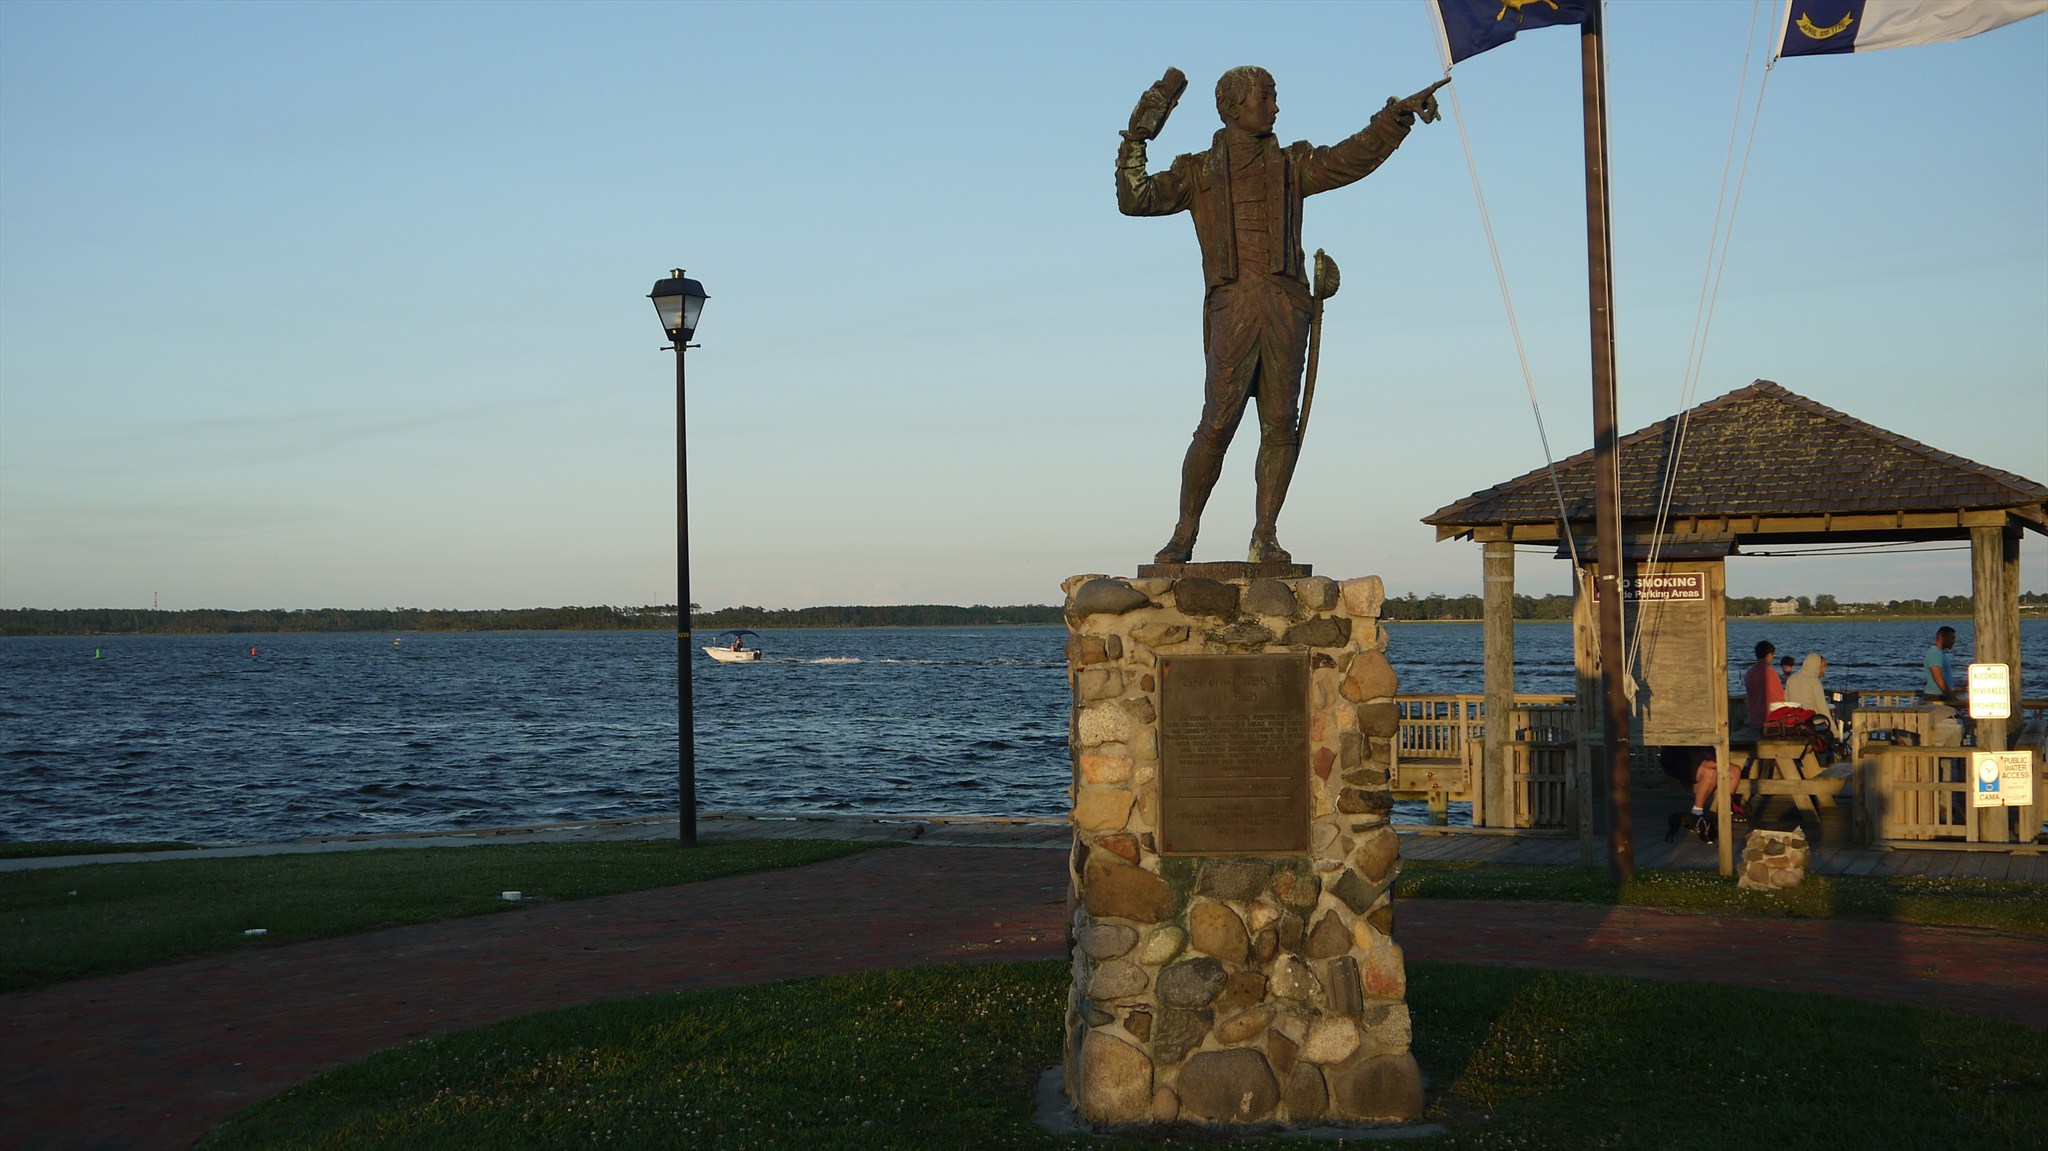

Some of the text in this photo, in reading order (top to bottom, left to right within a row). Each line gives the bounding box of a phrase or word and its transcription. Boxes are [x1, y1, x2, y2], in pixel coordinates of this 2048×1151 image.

[1635, 578, 1697, 587] SMOKING
[1635, 590, 1669, 599] Parking
[1973, 672, 2005, 680] ALCOHOLIC
